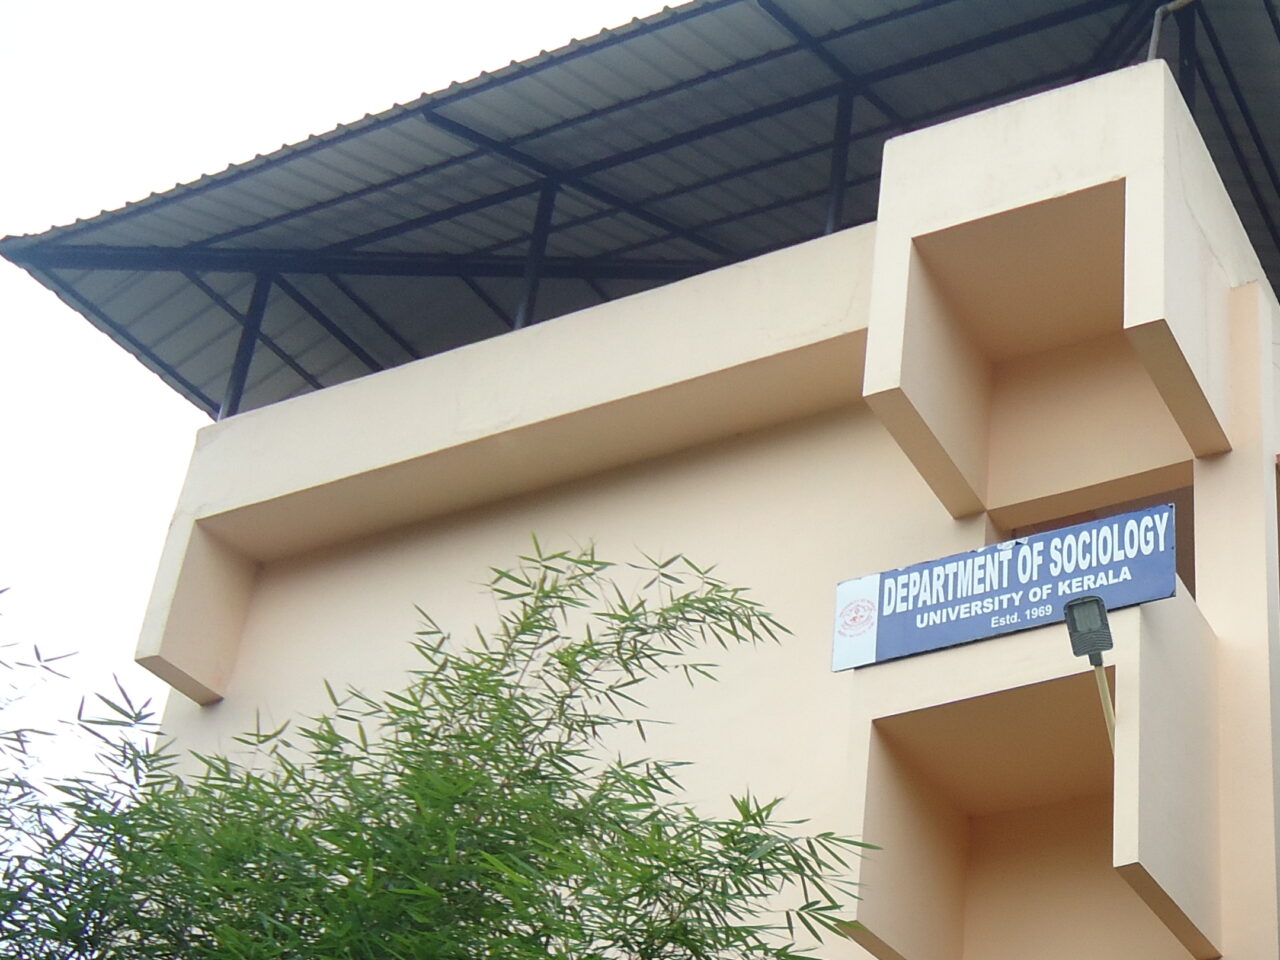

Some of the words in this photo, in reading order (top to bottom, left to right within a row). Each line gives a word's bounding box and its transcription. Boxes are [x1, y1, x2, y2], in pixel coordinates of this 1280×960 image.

[883, 549, 1012, 616] DEPARTMENT
[1018, 542, 1044, 584] OF
[1050, 512, 1169, 577] SOCIOLOGY
[916, 591, 1024, 628] UNIVERSITY
[1028, 584, 1052, 600] OF
[1058, 566, 1132, 597] KERALA
[991, 612, 1021, 628] Estd.
[1025, 605, 1052, 622] 1969
